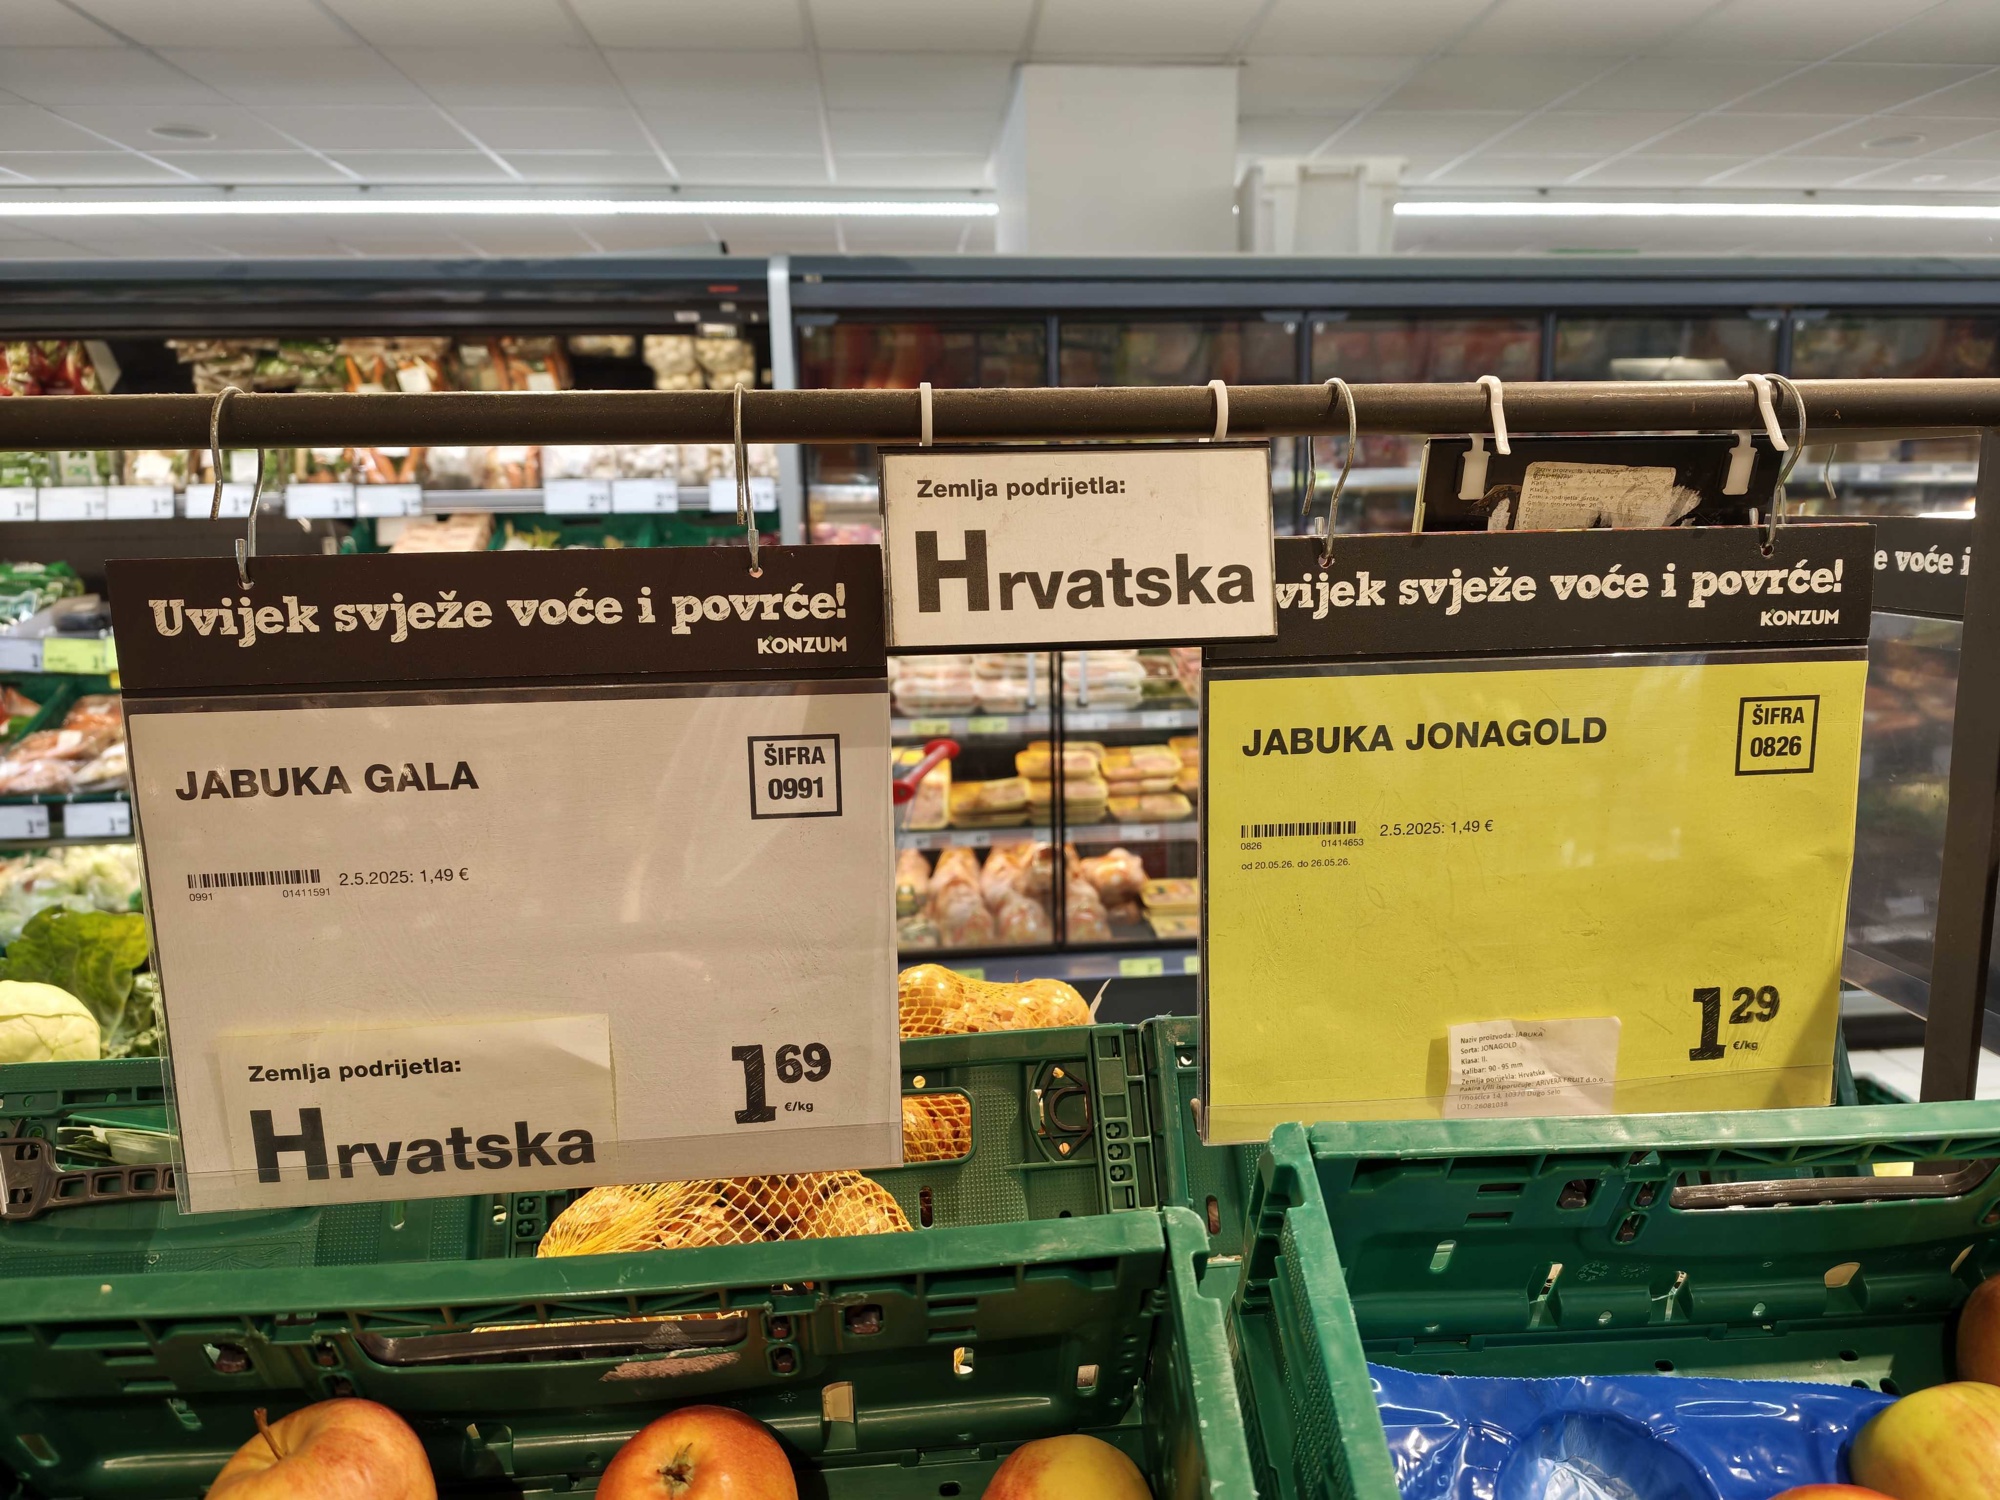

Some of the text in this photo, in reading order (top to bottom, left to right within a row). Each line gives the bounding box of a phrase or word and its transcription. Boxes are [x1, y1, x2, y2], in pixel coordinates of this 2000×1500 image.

[917, 477, 1126, 501] Zemlja podrijetla:
[1895, 545, 1954, 574] voće
[915, 530, 1255, 612] Hrvatska
[1276, 571, 1386, 619] vijek
[1399, 567, 1536, 615] svježe
[1550, 564, 1649, 601] voće
[1661, 563, 1677, 598] i
[1690, 559, 1843, 613] povrće!
[149, 583, 847, 647] Uvijek svježe voće i povrće!
[1760, 608, 1840, 627] KONZUM
[757, 636, 847, 655] KONZUM
[1752, 704, 1805, 726] ŠIFRA
[1243, 717, 1607, 757] JABUKA JONAGOLD
[763, 741, 827, 767] ŠIFRA
[1750, 736, 1801, 758] 0826
[176, 761, 479, 801] JABUKA GALA
[768, 777, 824, 801] 0991
[1379, 819, 1494, 837] 2.5.2025: 1,49 €
[1240, 838, 1364, 851] 0826 01414653
[1241, 858, 1351, 871] od 20.05.26. do 26.05.26.
[339, 867, 470, 886] 2.5.2025: 1,49 €
[189, 887, 331, 902] 0991 01411591
[1460, 1036, 1478, 1044] Naziv
[1478, 1033, 1514, 1044] proizvoda:
[1460, 1041, 1517, 1055] Sorta: JONAGOLD
[1732, 1040, 1759, 1051] €/kg
[248, 1057, 462, 1084] Zemlja podrijetla:
[1460, 1057, 1480, 1066] Klasa:
[1461, 1066, 1487, 1076] Kalibar:
[1488, 1064, 1497, 1072] 90
[1501, 1063, 1510, 1071] 95
[1518, 1069, 1546, 1079] Hrvatska
[1526, 1089, 1546, 1098] Dugo
[1546, 1088, 1561, 1096] Selo
[784, 1101, 814, 1113] €/kg
[250, 1108, 595, 1183] Hrvatska
